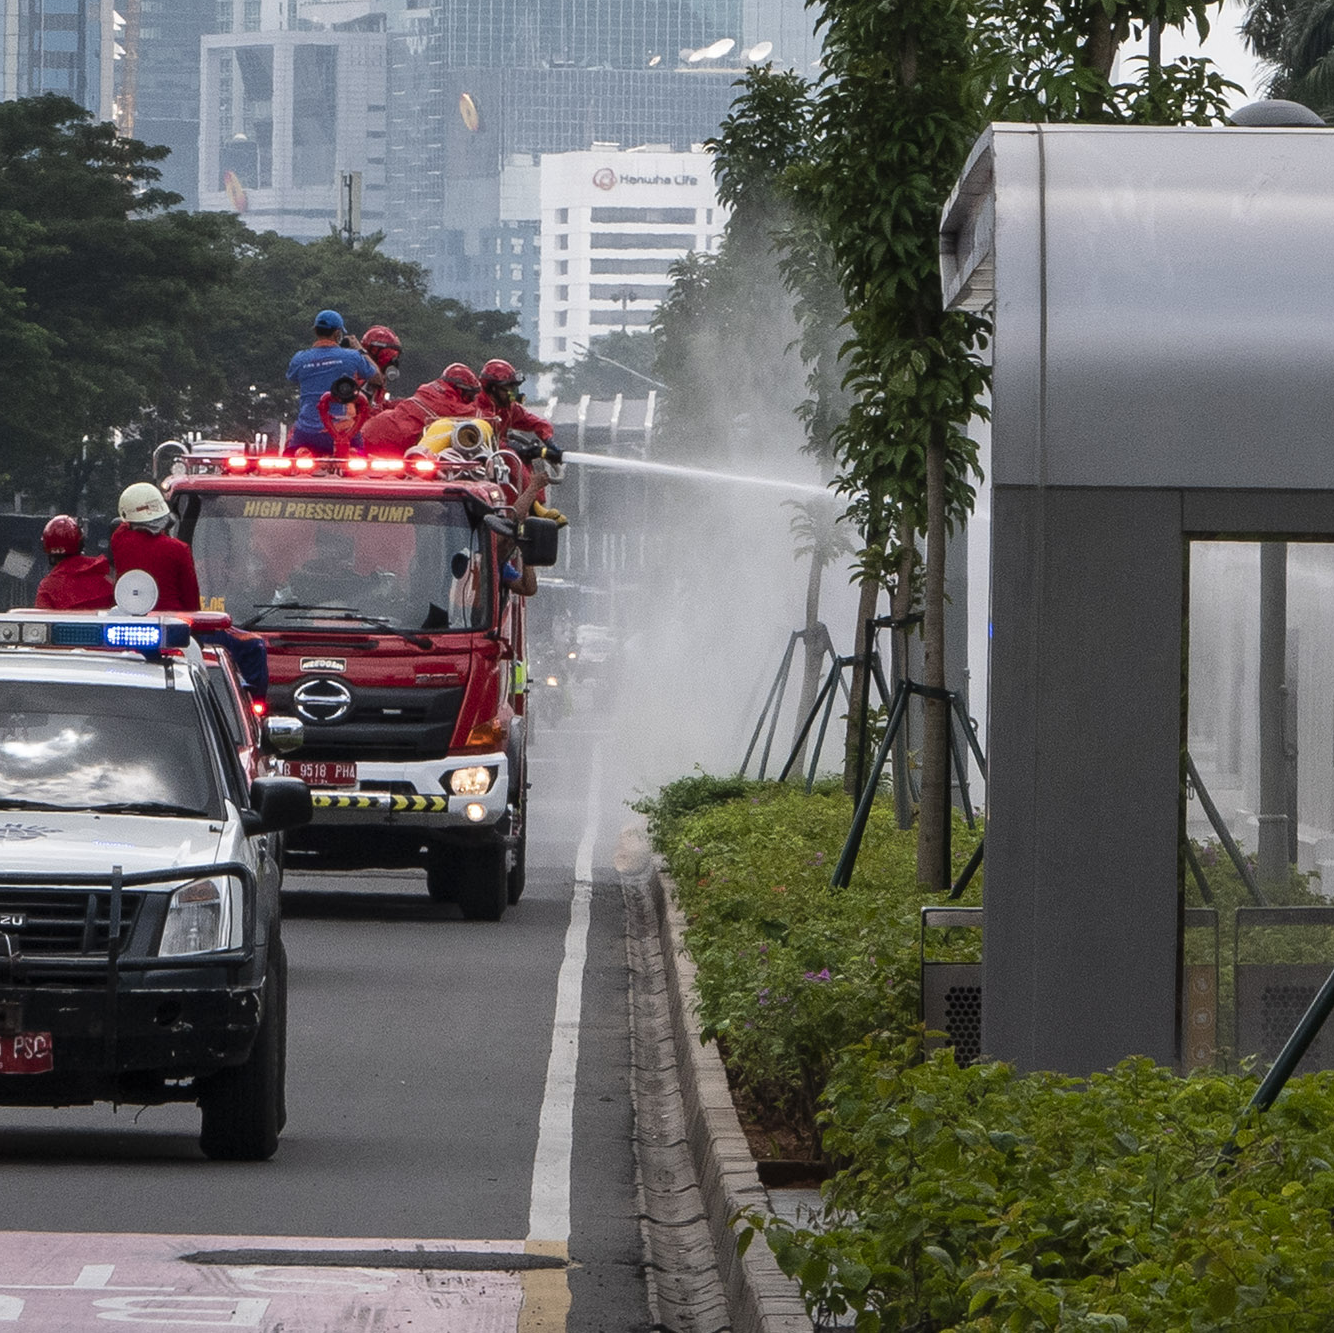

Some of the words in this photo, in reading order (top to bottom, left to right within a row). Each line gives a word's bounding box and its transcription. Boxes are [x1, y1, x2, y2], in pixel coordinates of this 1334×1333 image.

[619, 174, 671, 185] Hanwha
[674, 174, 698, 186] Life
[243, 501, 282, 517] HIGH
[285, 502, 364, 521] PRESSURE
[367, 505, 414, 523] PUMP
[300, 763, 327, 777] 9518
